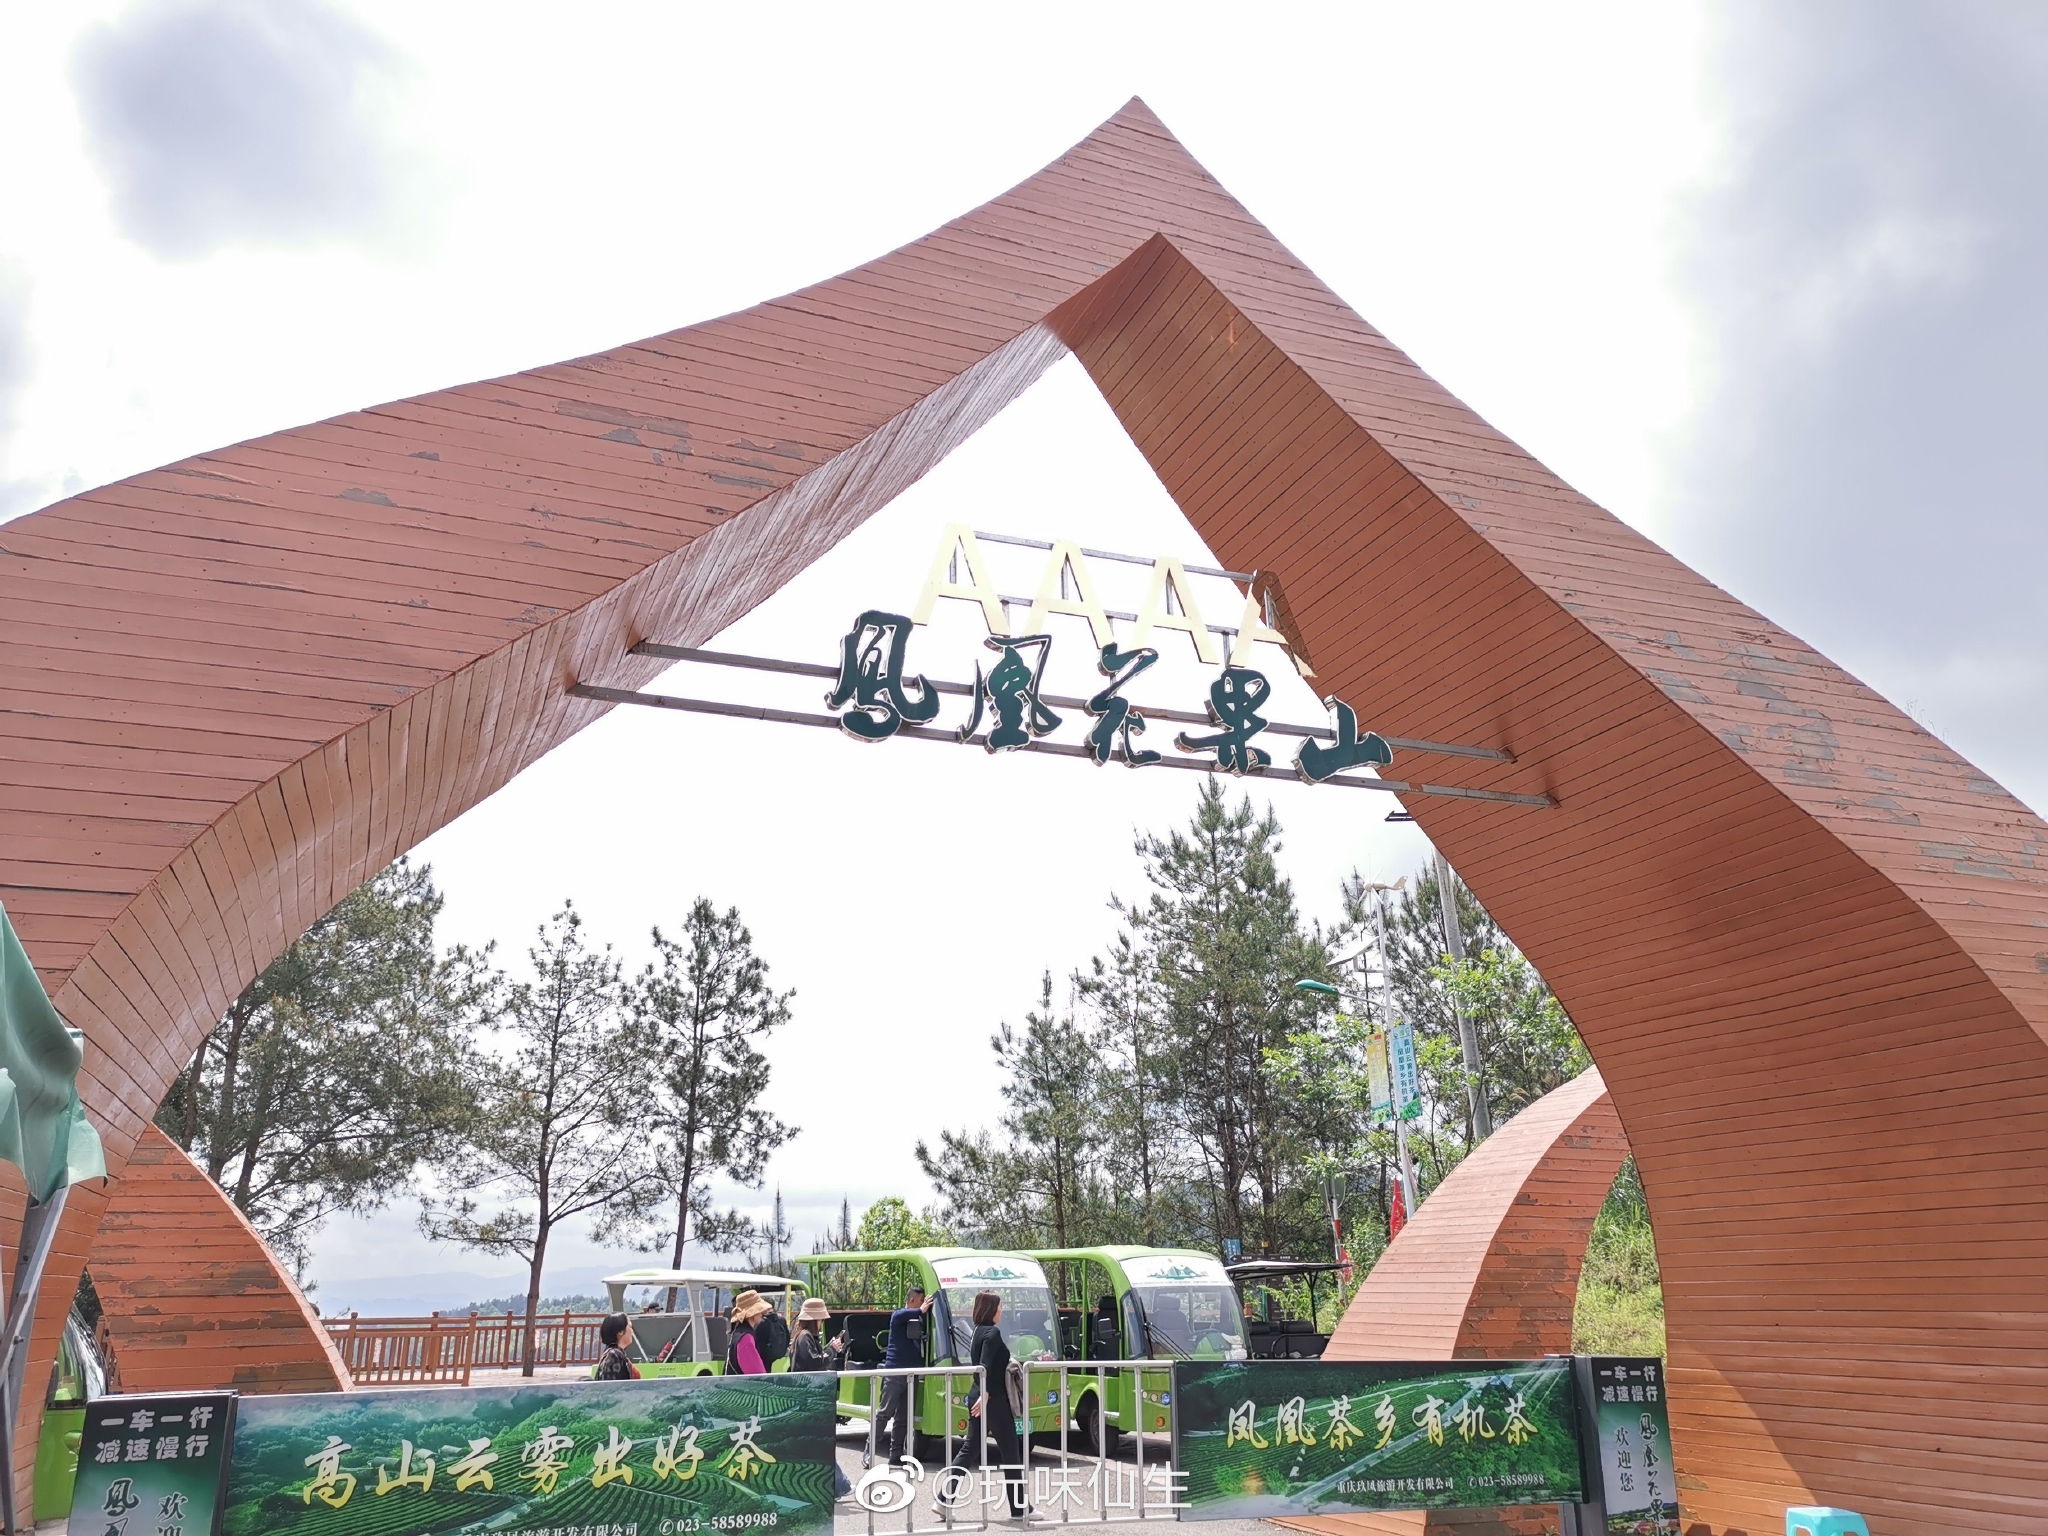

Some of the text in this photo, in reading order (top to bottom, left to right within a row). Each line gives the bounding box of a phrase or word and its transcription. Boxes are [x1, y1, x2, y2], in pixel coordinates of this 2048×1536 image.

[911, 523, 1317, 678] AAAA
[1600, 1365, 1656, 1382] 一车一杆
[1601, 1385, 1658, 1402] 减速慢行
[101, 1406, 213, 1432] 一车一杆
[1227, 1394, 1538, 1451] 凤凰茶乡有机茶
[95, 1434, 209, 1463] 减速慢行
[302, 1415, 776, 1509] 高山云雾出好茶
[1615, 1426, 1634, 1492] 欢迎您
[1478, 1474, 1545, 1487] 023-58589988
[676, 1512, 778, 1532] 023-58589988
